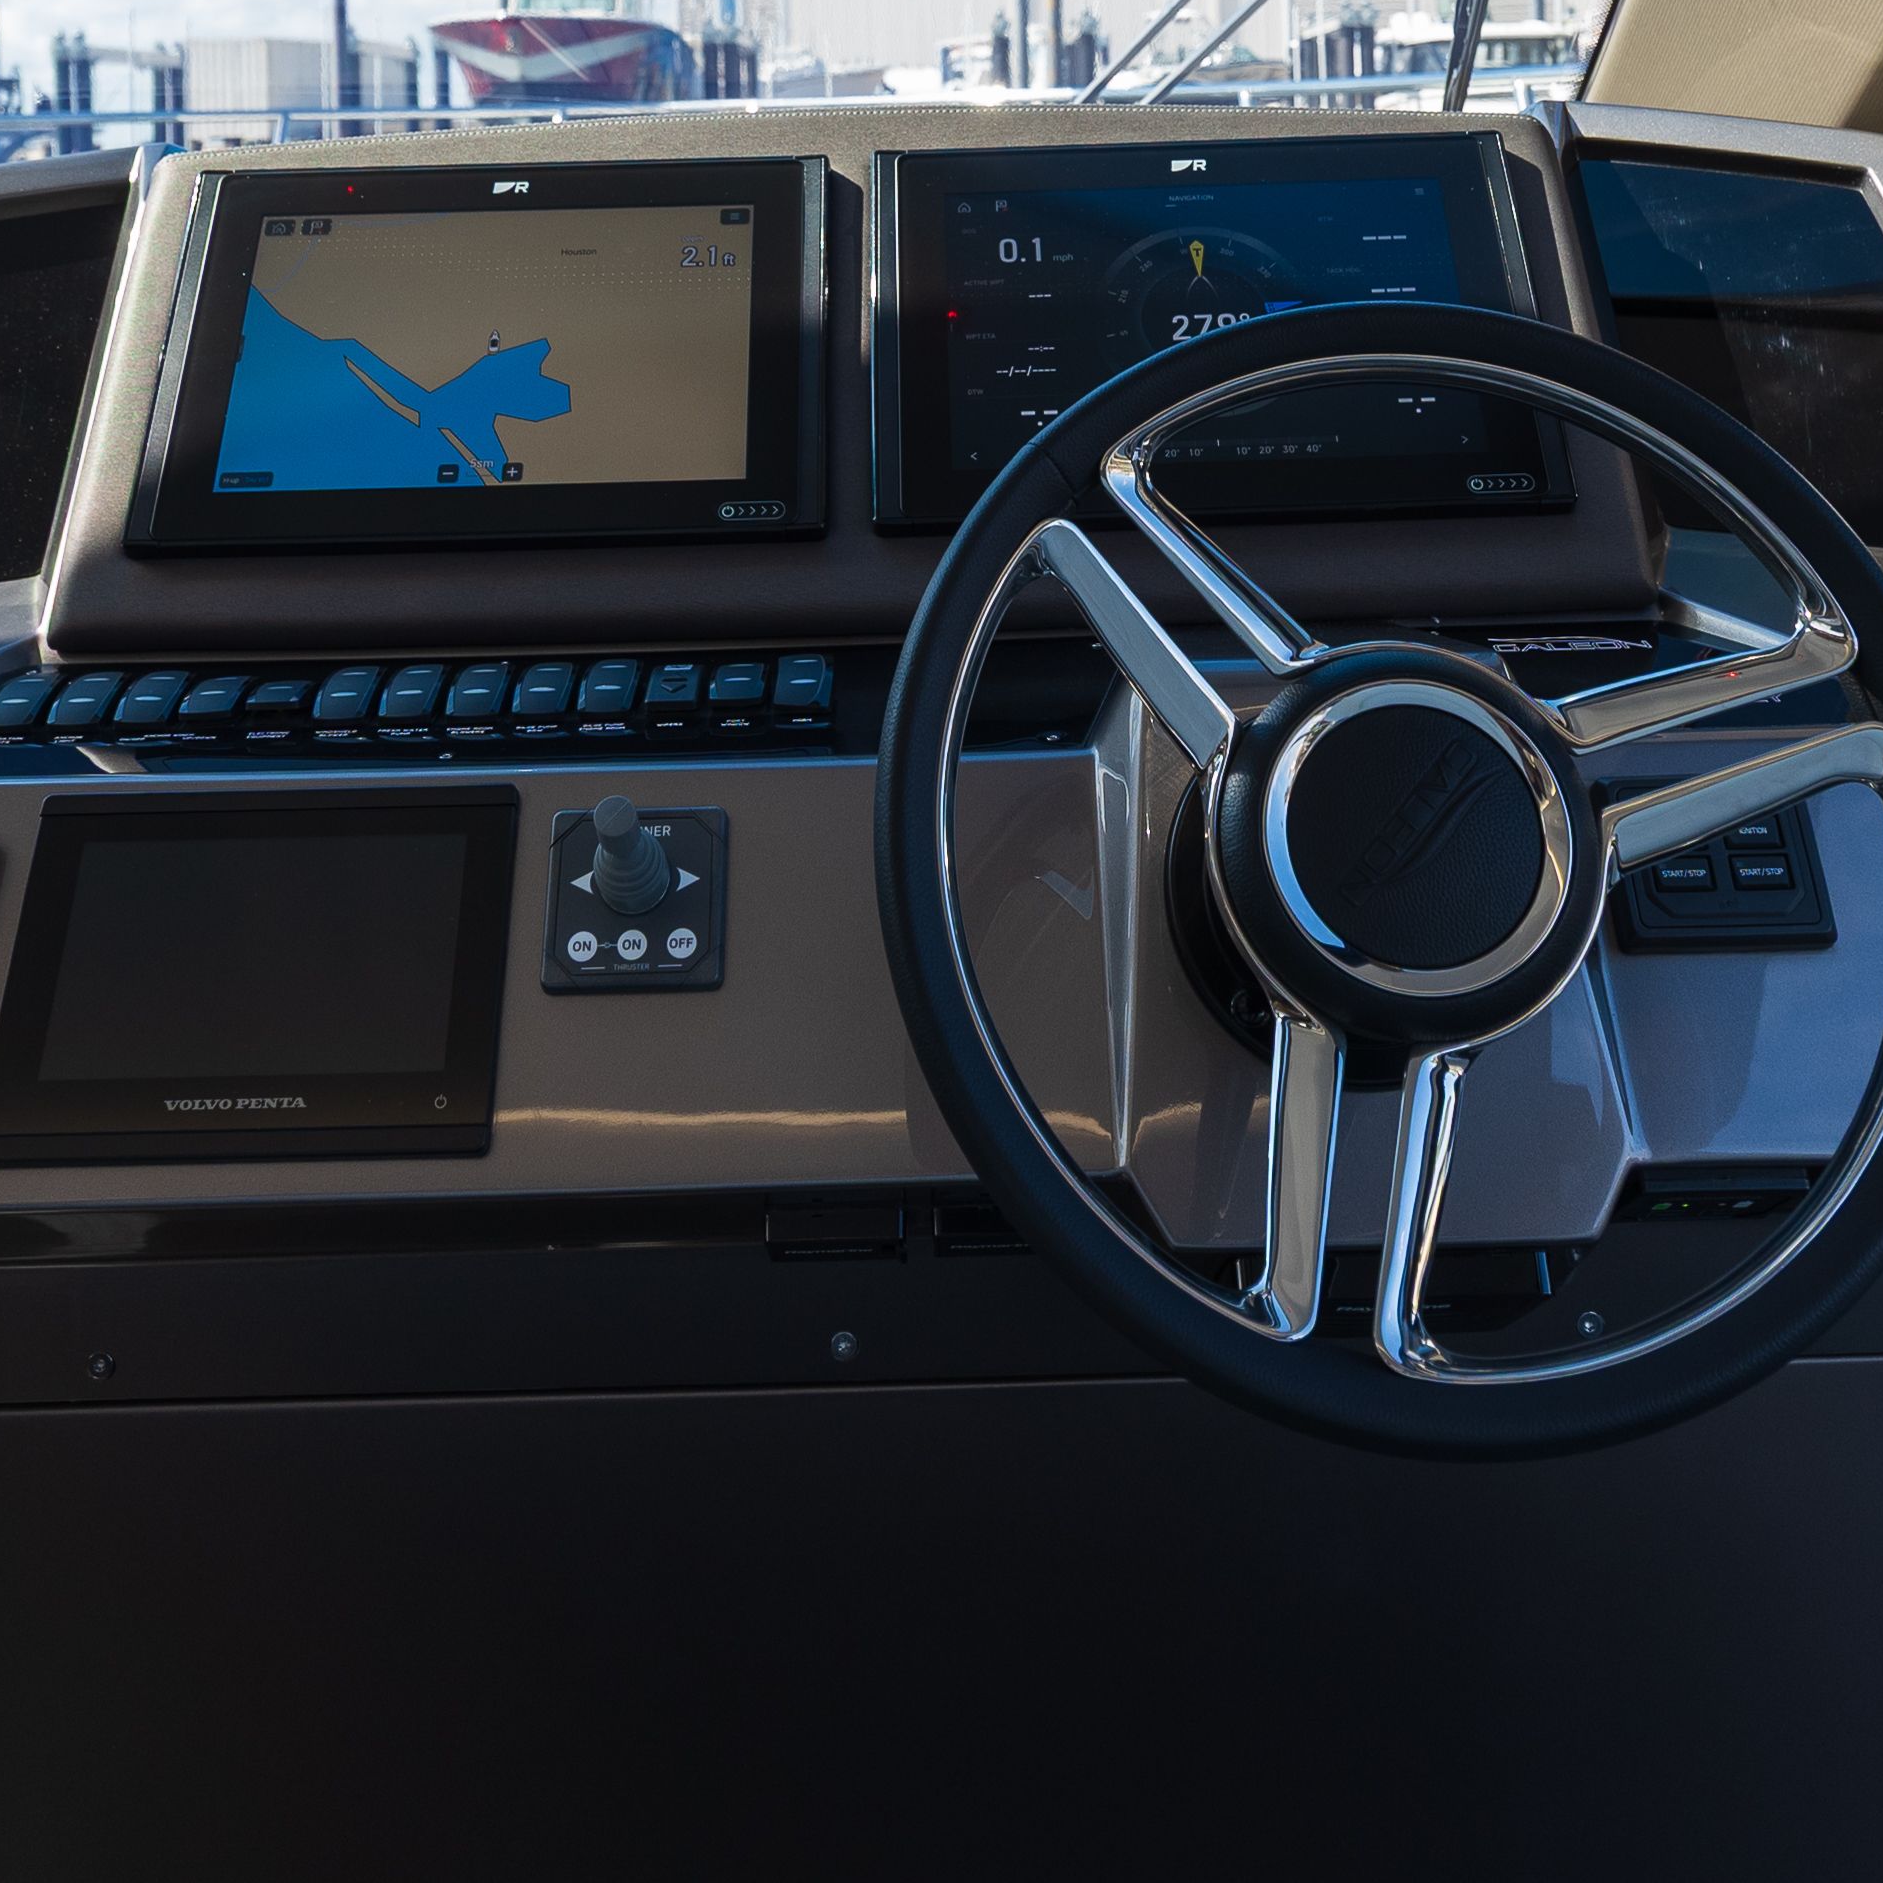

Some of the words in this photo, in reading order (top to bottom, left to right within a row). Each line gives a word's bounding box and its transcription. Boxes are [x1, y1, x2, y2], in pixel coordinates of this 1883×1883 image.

[561, 247, 597, 256] Houston
[999, 237, 1042, 263] 0.1
[1053, 253, 1074, 263] mph
[680, 245, 717, 268] 2.1
[722, 253, 737, 267] ft
[1165, 449, 1180, 457] 20°
[1189, 448, 1203, 457] 10°
[1236, 446, 1251, 455] 10°
[1259, 446, 1274, 455] 20°
[1282, 445, 1298, 454] 30°
[1306, 444, 1322, 453] 40°
[1739, 826, 1768, 835] IGNITION
[1662, 869, 1707, 878] START/STOP
[1739, 867, 1784, 877] START/STOP
[572, 940, 592, 952] ON
[622, 939, 642, 951] ON
[668, 937, 694, 949] OFF
[613, 963, 650, 972] THRUSTER
[164, 1099, 232, 1111] VOLVO
[235, 1097, 307, 1109] PENTA
